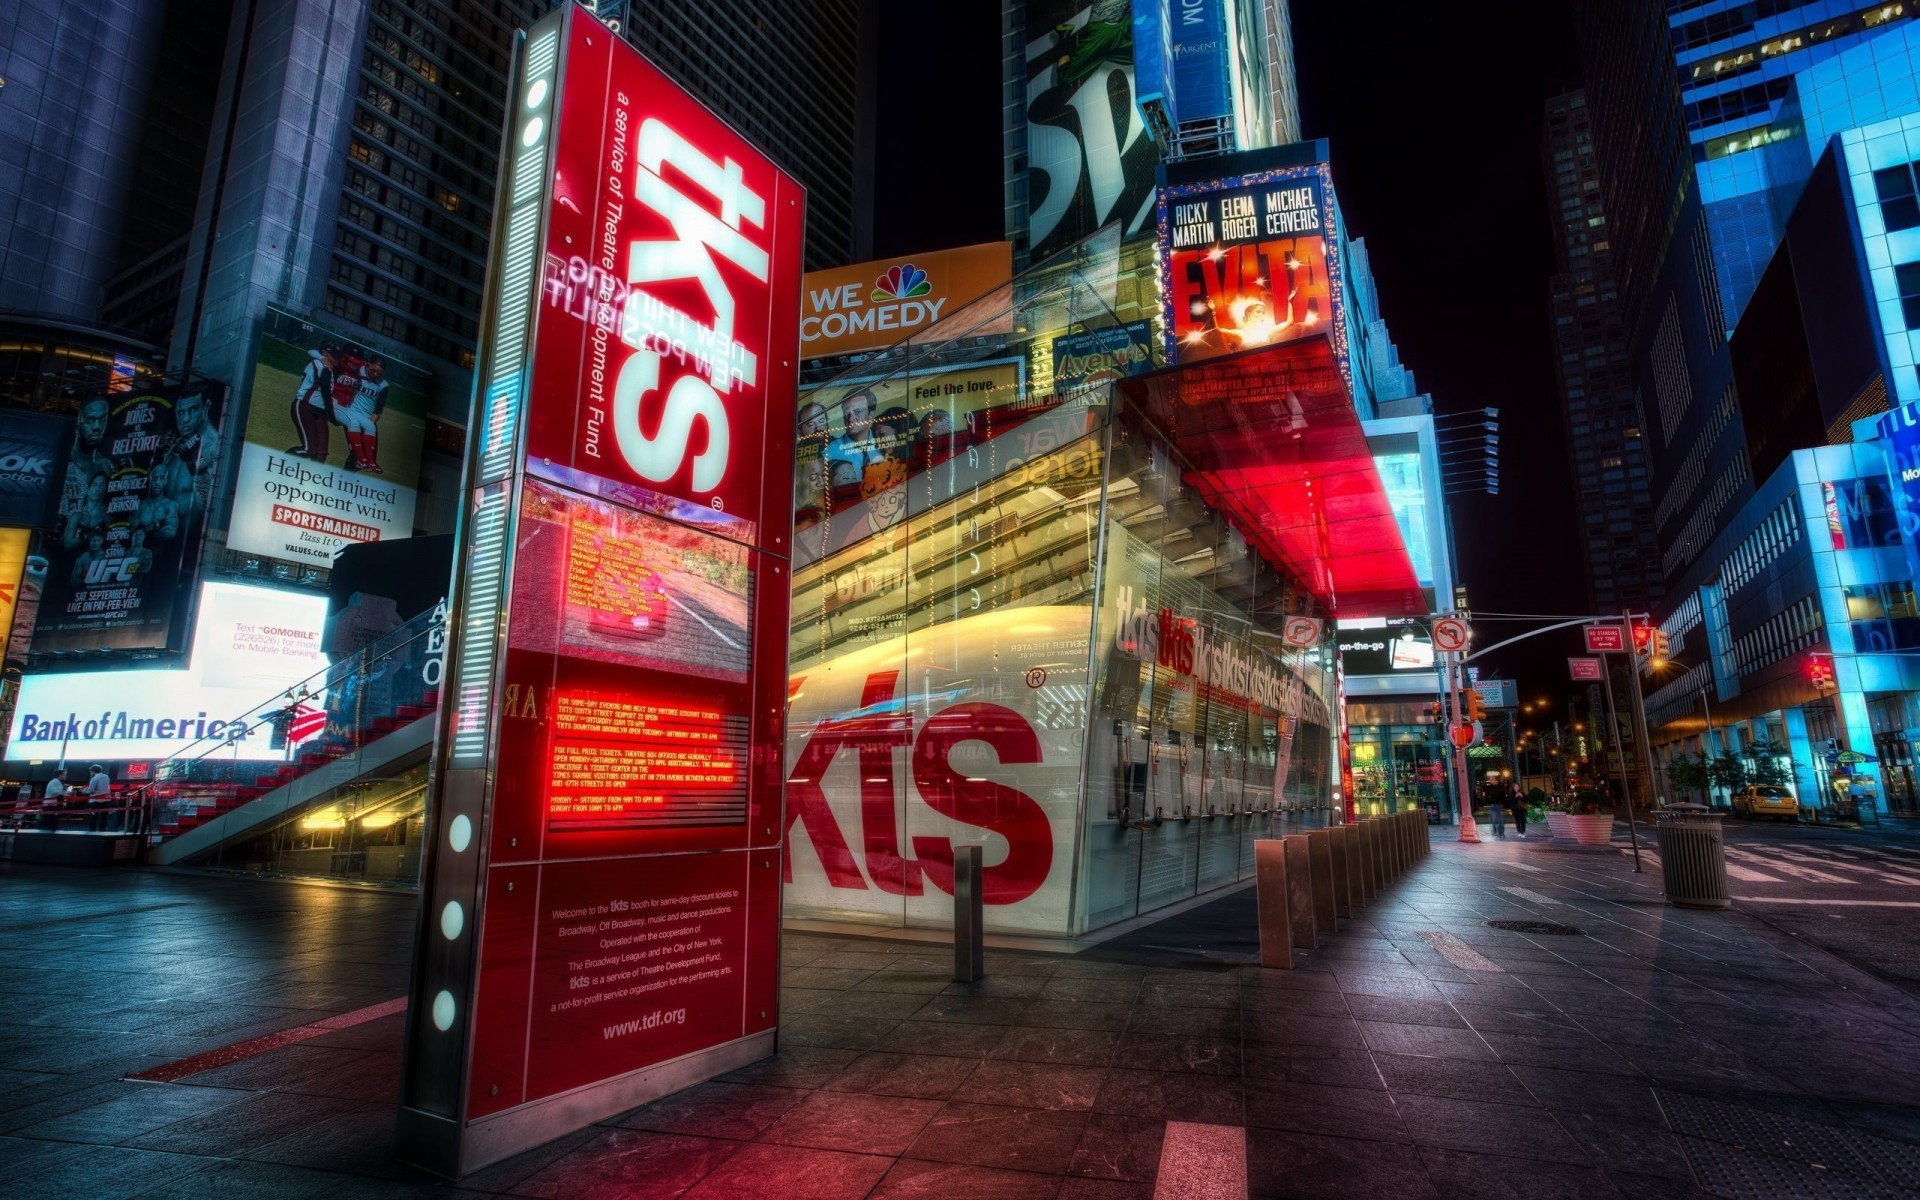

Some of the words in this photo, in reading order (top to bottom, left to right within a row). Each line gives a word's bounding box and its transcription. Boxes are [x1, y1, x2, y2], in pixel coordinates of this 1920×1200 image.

[1181, 41, 1217, 54] ARGENT
[618, 91, 629, 106] a
[613, 110, 628, 173] service
[612, 176, 623, 196] of
[1175, 202, 1208, 227] RICKY
[1221, 196, 1255, 221] ELENA
[1266, 187, 1316, 211] MICHAEL
[601, 202, 622, 271] Theatre
[1173, 221, 1215, 248] MARTIN
[1222, 216, 1258, 241] ROGER
[1266, 208, 1319, 234] CERVERIS
[1170, 237, 1328, 336] EVITA
[613, 117, 769, 492] tkts
[810, 283, 863, 312] WE
[800, 297, 947, 341] COMEDY
[592, 274, 616, 408] Development
[915, 386, 940, 399] Feel
[944, 382, 963, 396] the
[967, 379, 997, 395] love.
[124, 407, 156, 426] JONES
[185, 433, 200, 449] UFC
[585, 410, 603, 458] Fund
[112, 435, 157, 455] BELFORT
[108, 477, 148, 491] BENAVIDEZ
[266, 455, 334, 488] Helped
[338, 474, 396, 505] injured
[107, 500, 140, 514] JOHNSON
[264, 481, 351, 512] opponent
[357, 503, 391, 522] win.
[275, 507, 378, 542] SPORTSMANSHIP
[300, 530, 320, 544] Pass
[322, 534, 332, 545] It
[285, 544, 330, 559] VALUES.COM
[84, 557, 138, 583] UFC
[75, 591, 88, 602] SAT
[88, 589, 127, 602] SEPTEMBER
[128, 588, 138, 599] 22
[67, 602, 82, 613] LIVE
[82, 602, 93, 612] ON
[93, 598, 141, 611] PAY-PER-VIEW
[236, 623, 255, 633] Text
[234, 633, 280, 645] (226526)
[282, 639, 295, 647] for
[297, 641, 319, 649] more
[248, 643, 279, 654] Mobile
[1159, 608, 1195, 677] tkts
[1339, 642, 1384, 652] on-the-go
[558, 697, 569, 705] FOR
[558, 705, 573, 713] TKTS
[593, 709, 613, 717] STREET
[20, 713, 82, 741] Bank
[84, 711, 111, 740] of
[110, 711, 249, 741] America
[557, 722, 571, 730] TKTS
[586, 716, 612, 725] SATURDAY
[554, 746, 565, 754] FOR
[567, 747, 579, 755] FULL
[553, 771, 570, 779] TIMES
[580, 780, 604, 788] STREETS
[580, 796, 606, 804] SATURDAY
[552, 908, 588, 920] Welcome
[588, 906, 596, 915] to
[597, 905, 609, 914] the
[610, 900, 629, 912] tkts
[631, 900, 650, 910] booth
[651, 899, 659, 907] for
[660, 895, 690, 906] same-day
[691, 892, 715, 902] discount
[715, 890, 732, 899] tickets
[559, 925, 598, 937] Broadway,
[599, 921, 611, 931] Off
[612, 918, 647, 930] Broadway,
[648, 914, 666, 924] music
[667, 912, 679, 922] and
[680, 910, 698, 920] dance
[600, 935, 632, 949] Operated
[633, 931, 646, 943] with
[648, 931, 658, 941] the
[658, 927, 694, 940] cooperation
[695, 924, 701, 933] of
[569, 962, 583, 971] The
[585, 956, 620, 969] Broadway
[621, 951, 646, 963] League
[648, 947, 660, 958] and
[662, 946, 672, 955] the
[673, 943, 686, 954] City
[687, 941, 693, 950] of
[694, 940, 708, 949] New
[570, 975, 590, 990] tkts
[592, 976, 598, 985] is
[606, 971, 631, 983] service
[632, 968, 639, 976] of
[640, 964, 665, 976] Theatre
[666, 956, 705, 971] Development
[551, 1004, 556, 1012] a
[558, 993, 603, 1010] not-for-profit
[603, 988, 628, 1001] service
[629, 980, 668, 996] organization
[669, 977, 678, 986] for
[678, 975, 688, 984] the
[689, 969, 720, 984] performing
[603, 1007, 686, 1040] www.tdf.org
